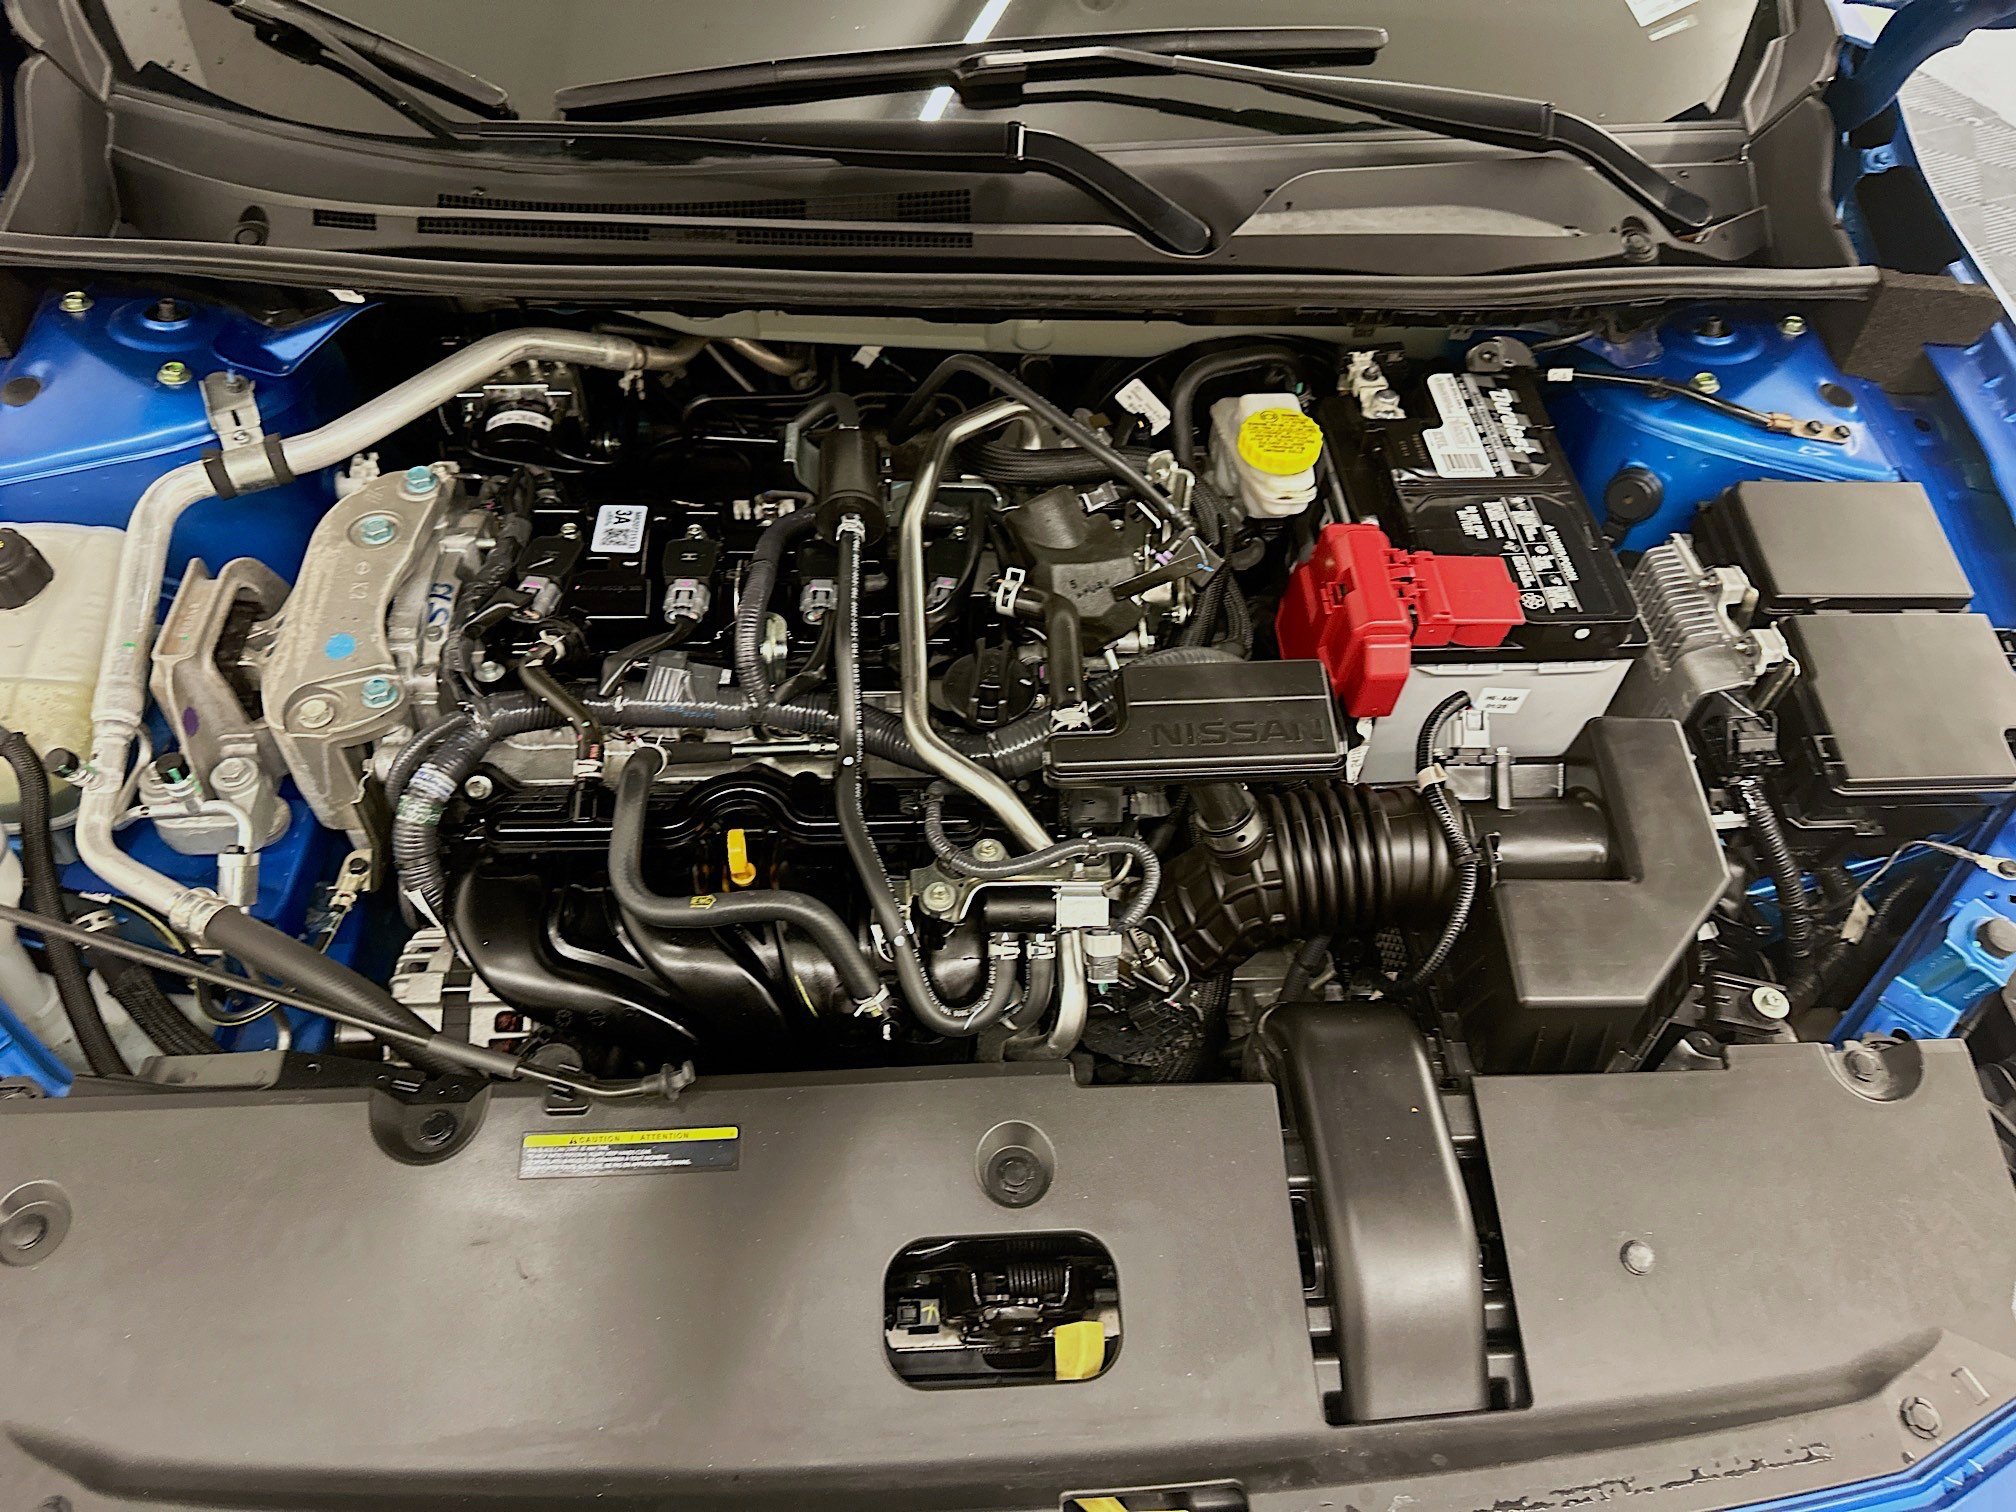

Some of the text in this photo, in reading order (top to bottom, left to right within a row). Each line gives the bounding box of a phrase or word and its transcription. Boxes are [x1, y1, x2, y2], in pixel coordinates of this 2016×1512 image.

[1489, 388, 1538, 454] Duralast
[613, 509, 632, 525] 3A
[1150, 718, 1325, 748] NISSAN
[579, 1135, 621, 1144] CAUTION
[639, 1131, 690, 1141] ATTENTION
